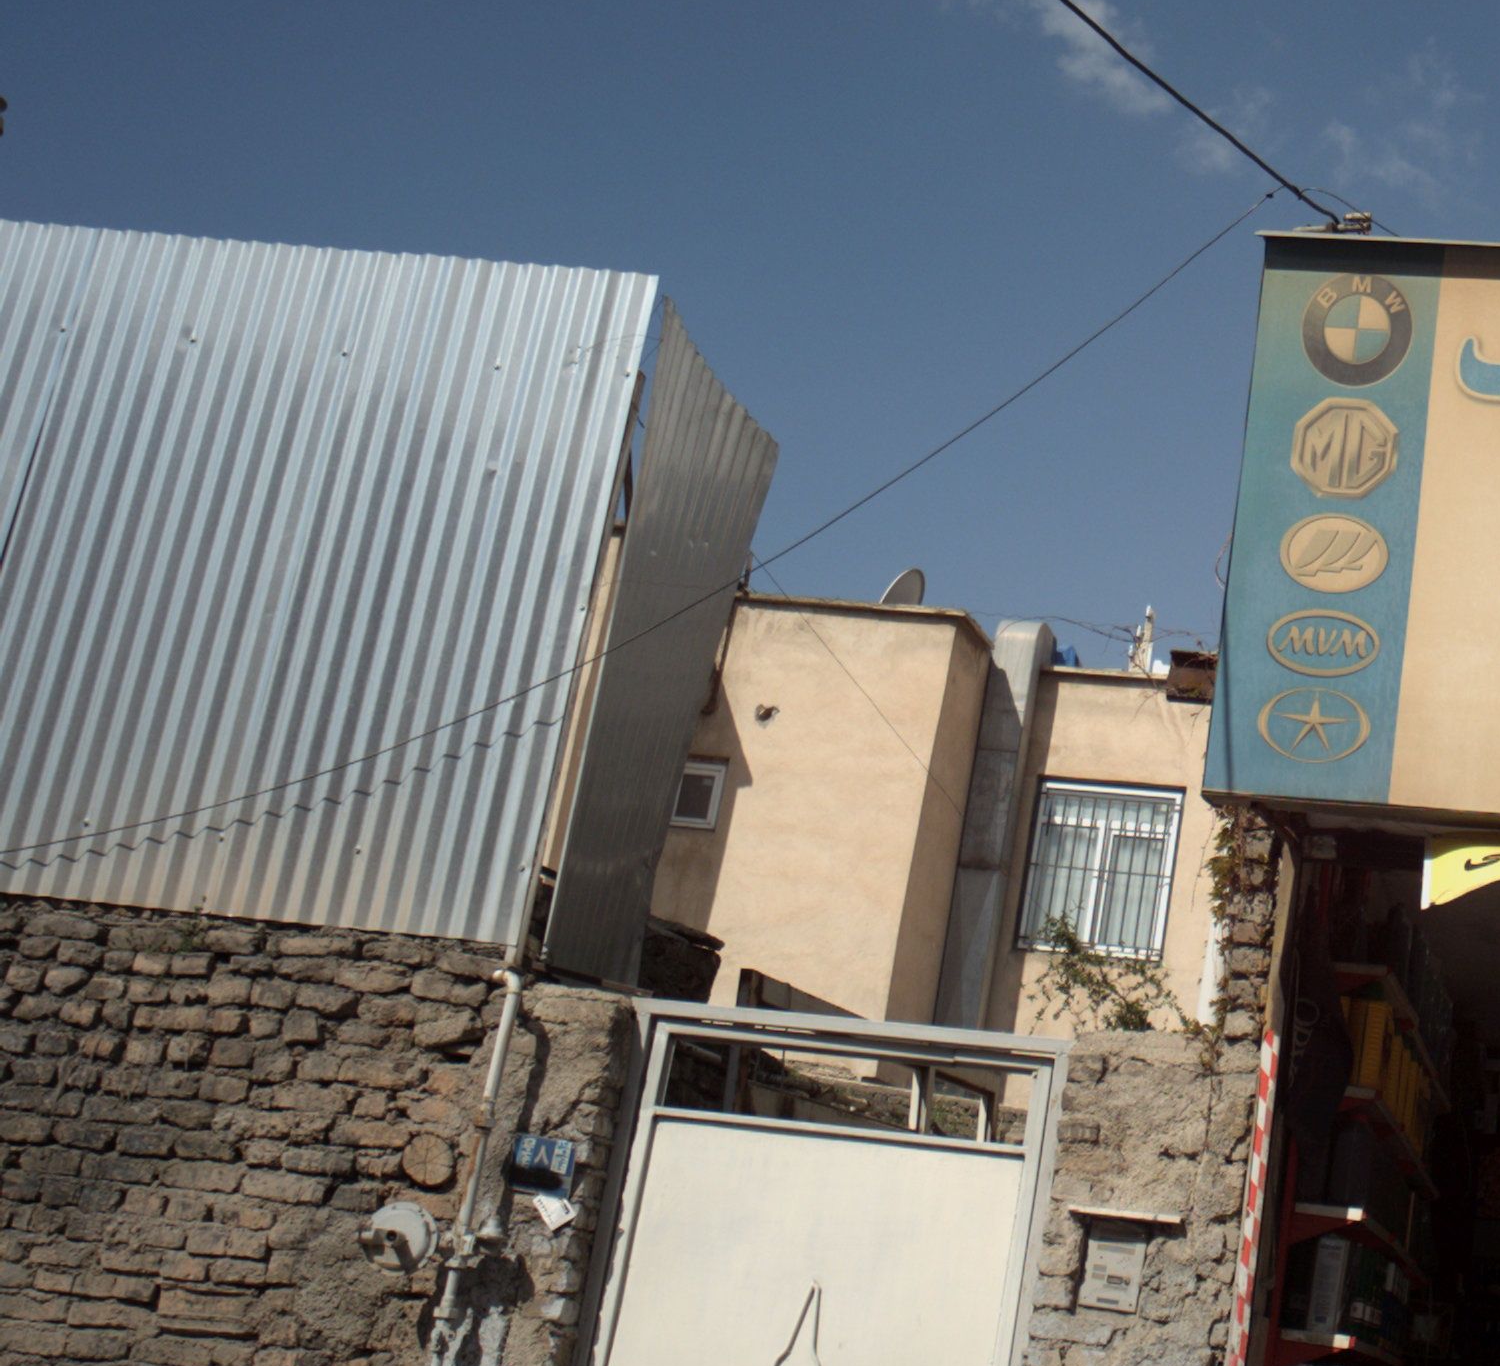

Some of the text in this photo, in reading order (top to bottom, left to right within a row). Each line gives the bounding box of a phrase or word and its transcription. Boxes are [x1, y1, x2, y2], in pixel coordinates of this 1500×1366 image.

[1316, 275, 1406, 314] BMW
[1303, 407, 1387, 488] MG
[1277, 624, 1369, 658] MVM
